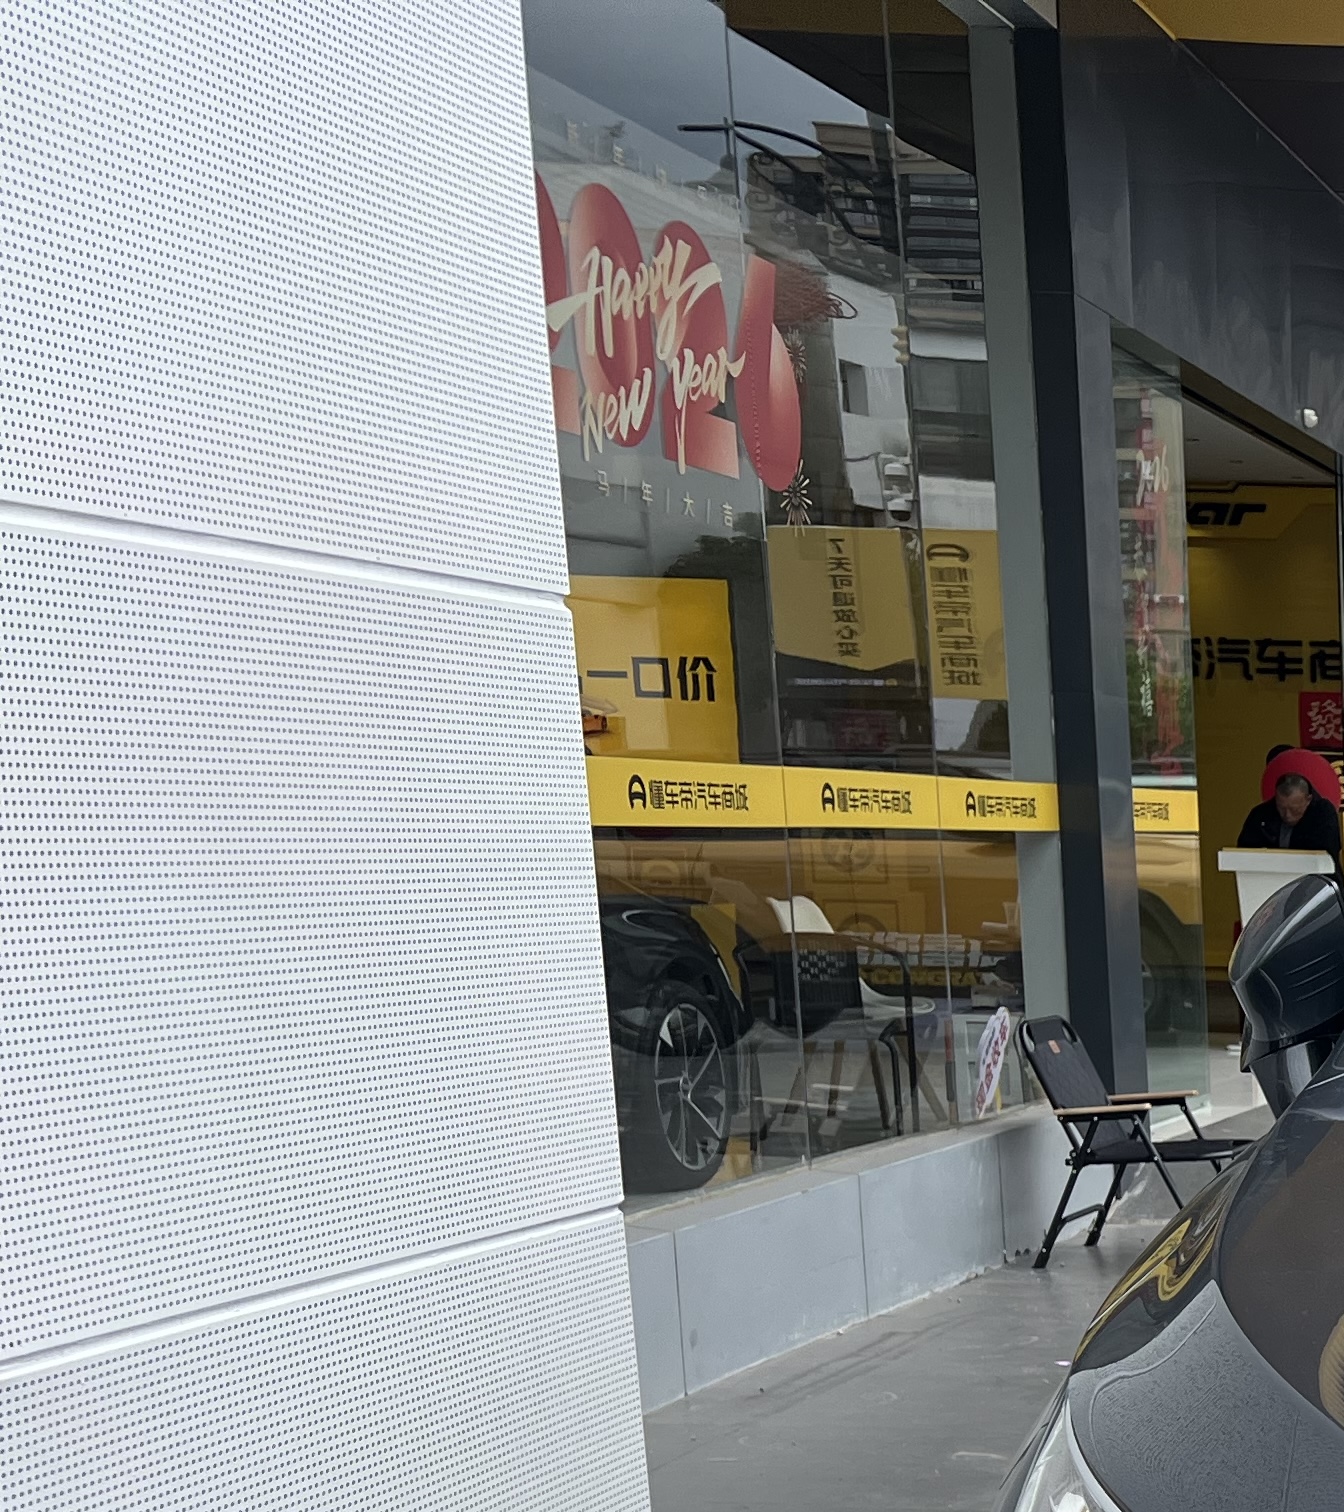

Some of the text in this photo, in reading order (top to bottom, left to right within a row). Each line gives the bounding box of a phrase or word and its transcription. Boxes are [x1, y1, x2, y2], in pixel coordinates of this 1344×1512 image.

[548, 235, 721, 361] Happy
[582, 367, 651, 461] New
[587, 656, 717, 702] 一口价
[1191, 636, 1342, 683] 汽车商
